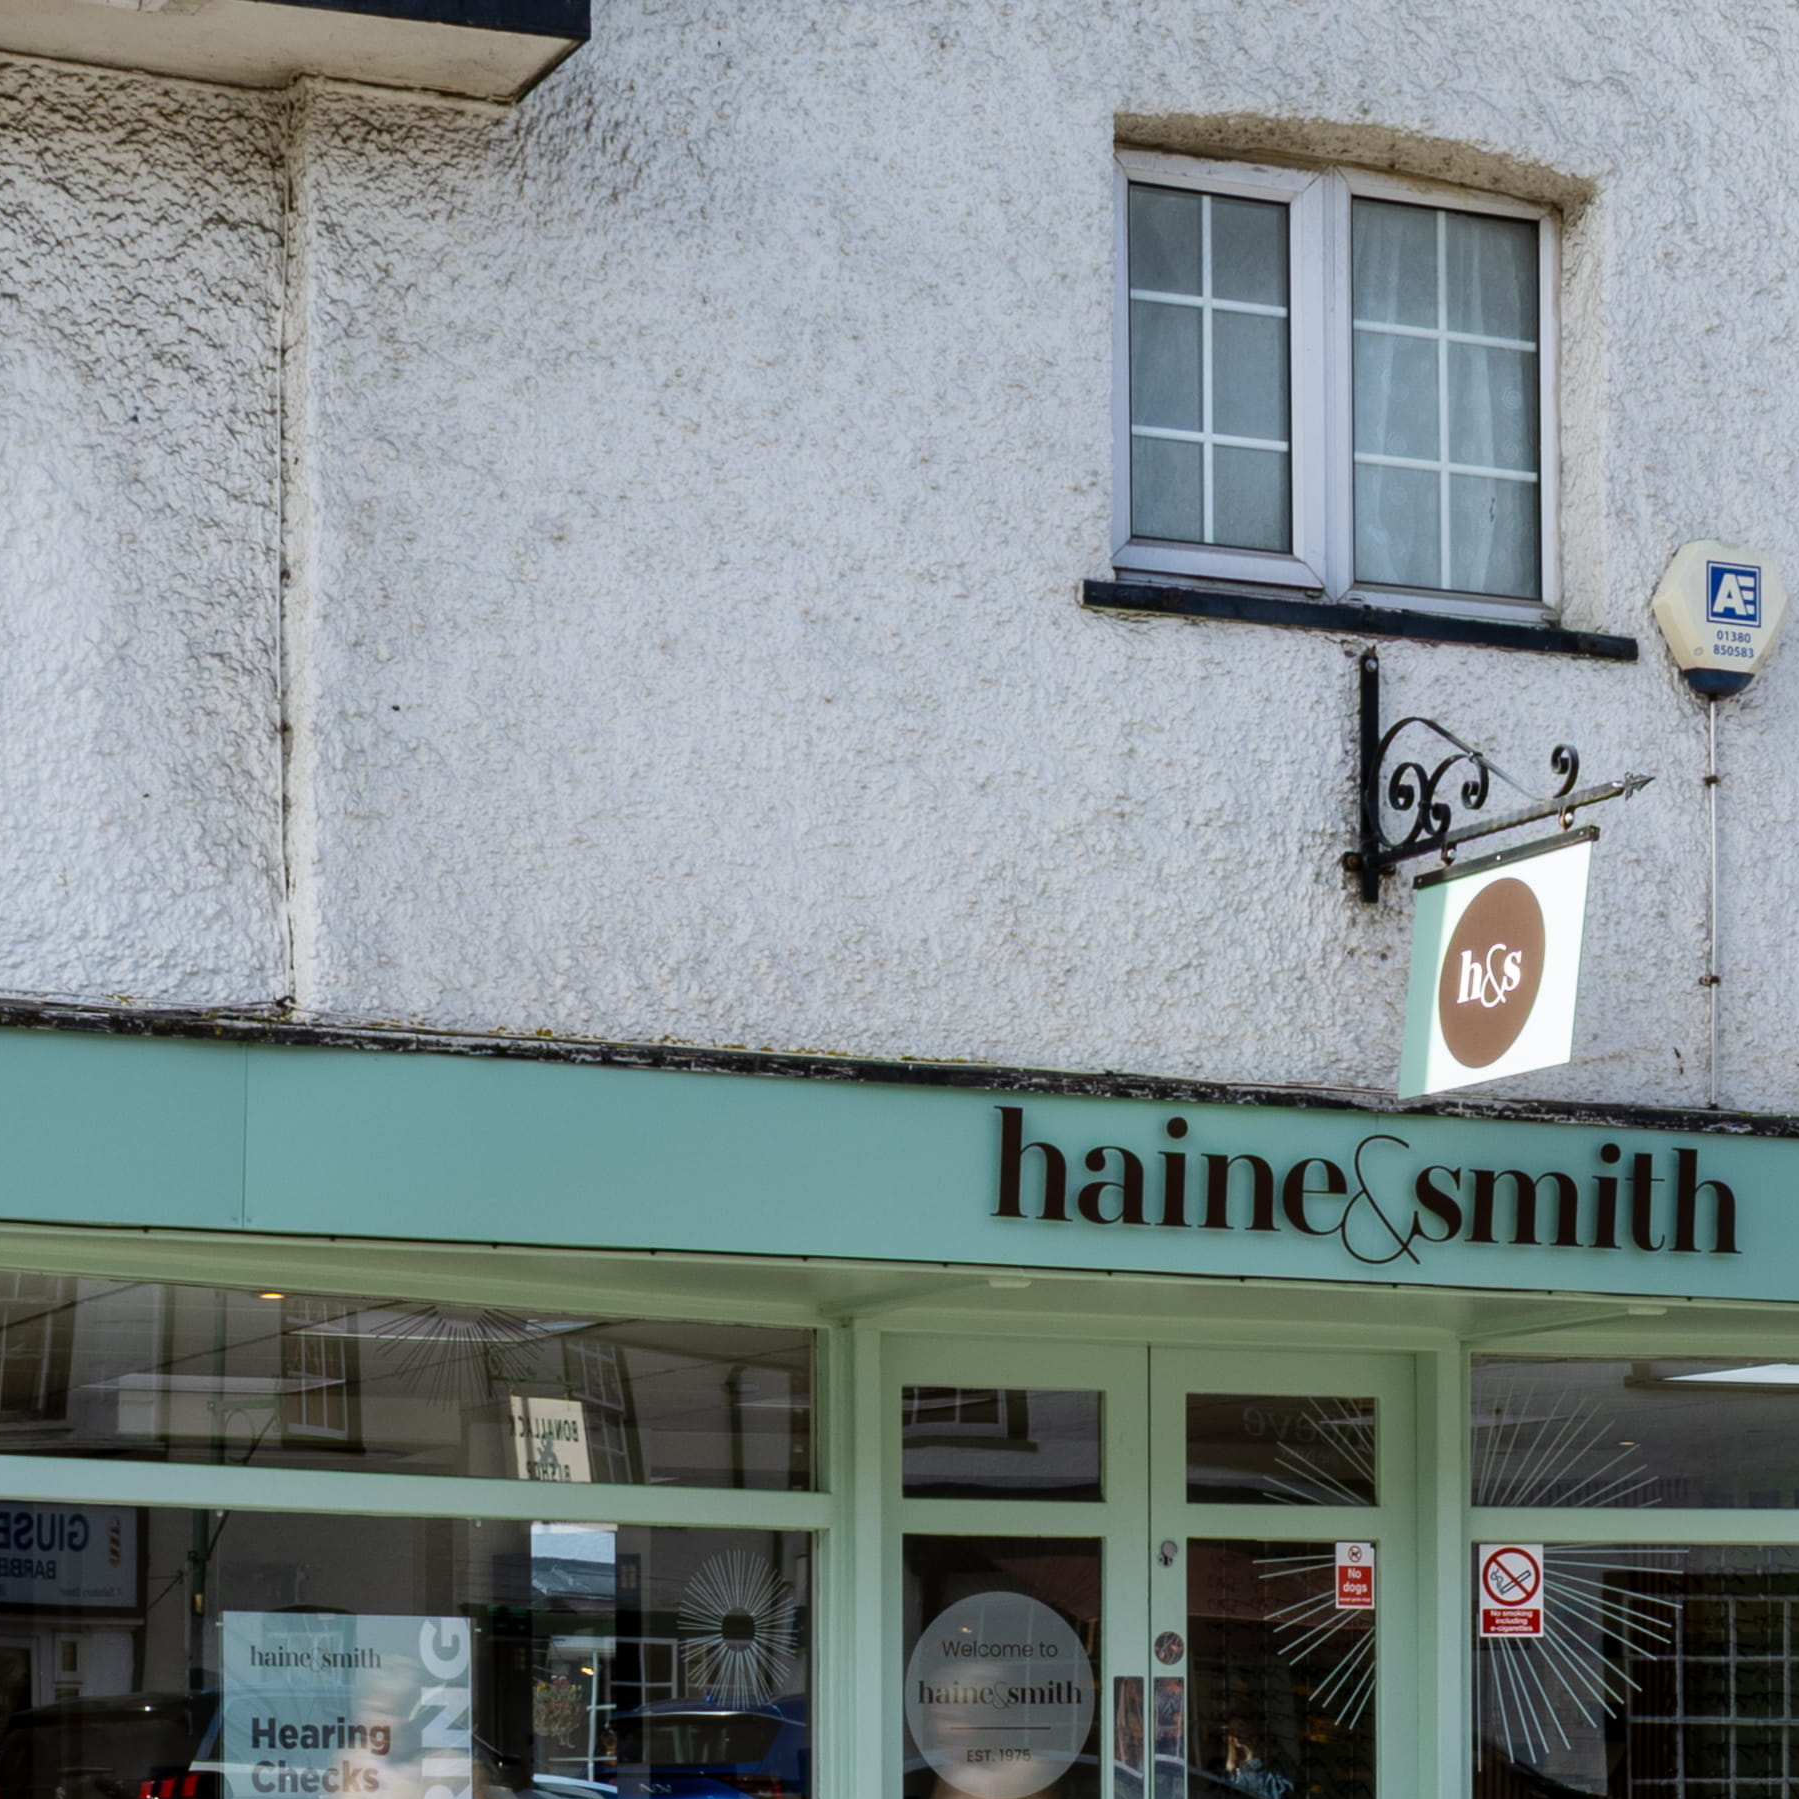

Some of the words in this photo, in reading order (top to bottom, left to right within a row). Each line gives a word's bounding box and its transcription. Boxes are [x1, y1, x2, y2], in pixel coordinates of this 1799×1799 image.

[1716, 628, 1752, 646] 01380
[1712, 643, 1756, 660] 850583
[1456, 943, 1523, 1009] h&s
[990, 1106, 1741, 1265] haine&smith
[1347, 1567, 1361, 1578] No
[1343, 1580, 1368, 1595] dogs
[1489, 1609, 1499, 1617] No
[1500, 1609, 1533, 1619] smoking
[1495, 1617, 1528, 1626] including
[1490, 1625, 1533, 1633] e-cigarettes
[250, 1644, 381, 1672] haine&smith
[942, 1640, 1034, 1658] Welcome
[1040, 1641, 1058, 1658] to
[917, 1680, 1083, 1710] haine&smith
[251, 1717, 391, 1756] Hearing
[966, 1749, 996, 1763] EST.
[999, 1747, 1032, 1762] 1975
[251, 1759, 380, 1793] Checks
